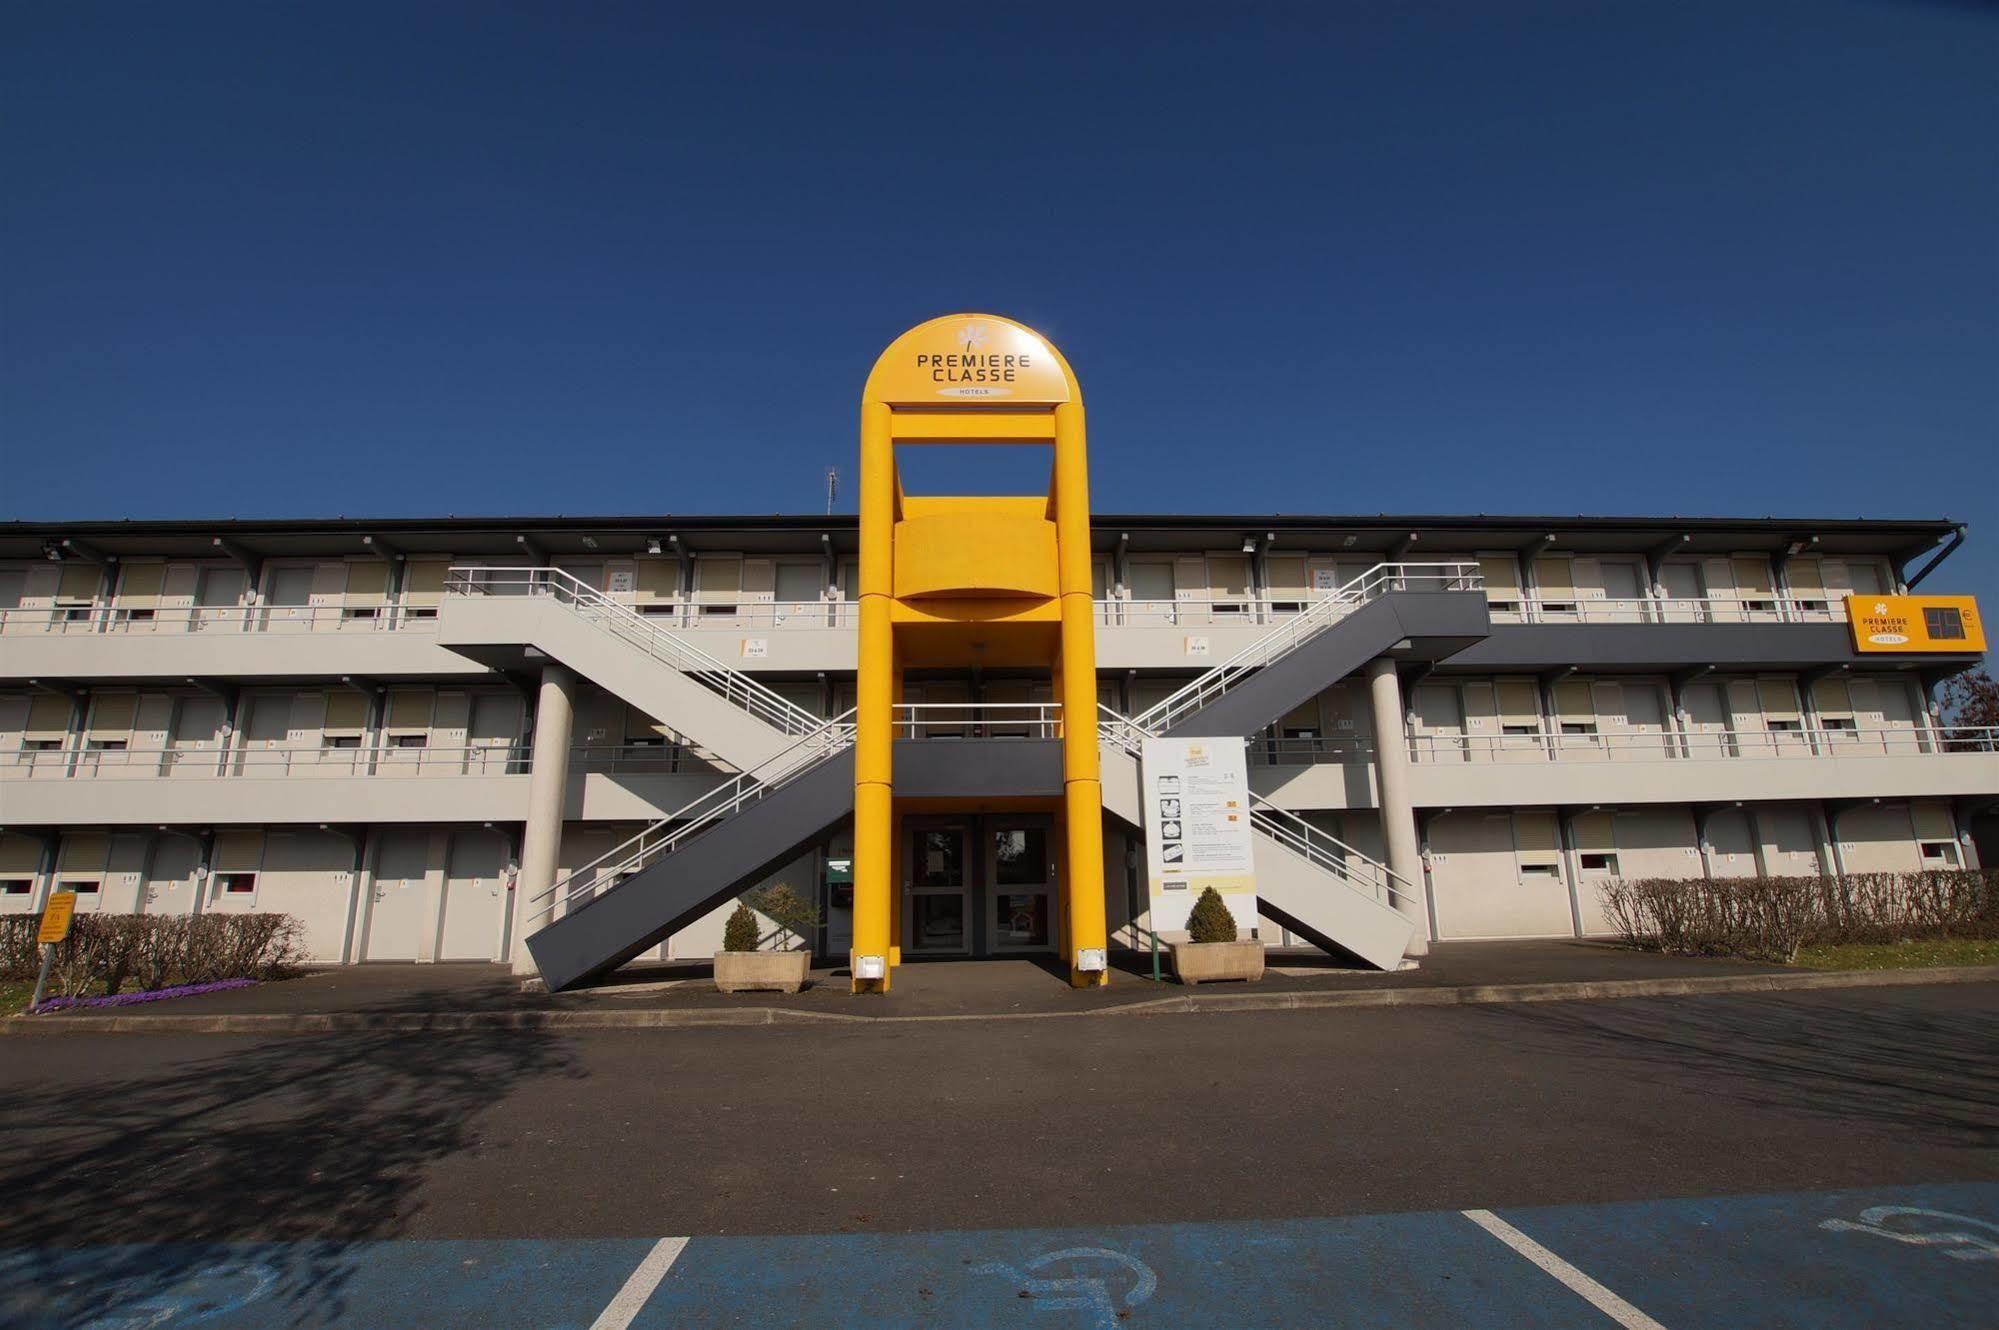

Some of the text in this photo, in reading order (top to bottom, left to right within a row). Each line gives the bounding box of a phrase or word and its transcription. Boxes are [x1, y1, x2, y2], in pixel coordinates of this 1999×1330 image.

[917, 354, 1030, 368] PREMIERE
[933, 369, 1015, 382] CLASSE
[1862, 617, 1908, 625] PREMIERE
[1870, 625, 1904, 633] CLASSE
